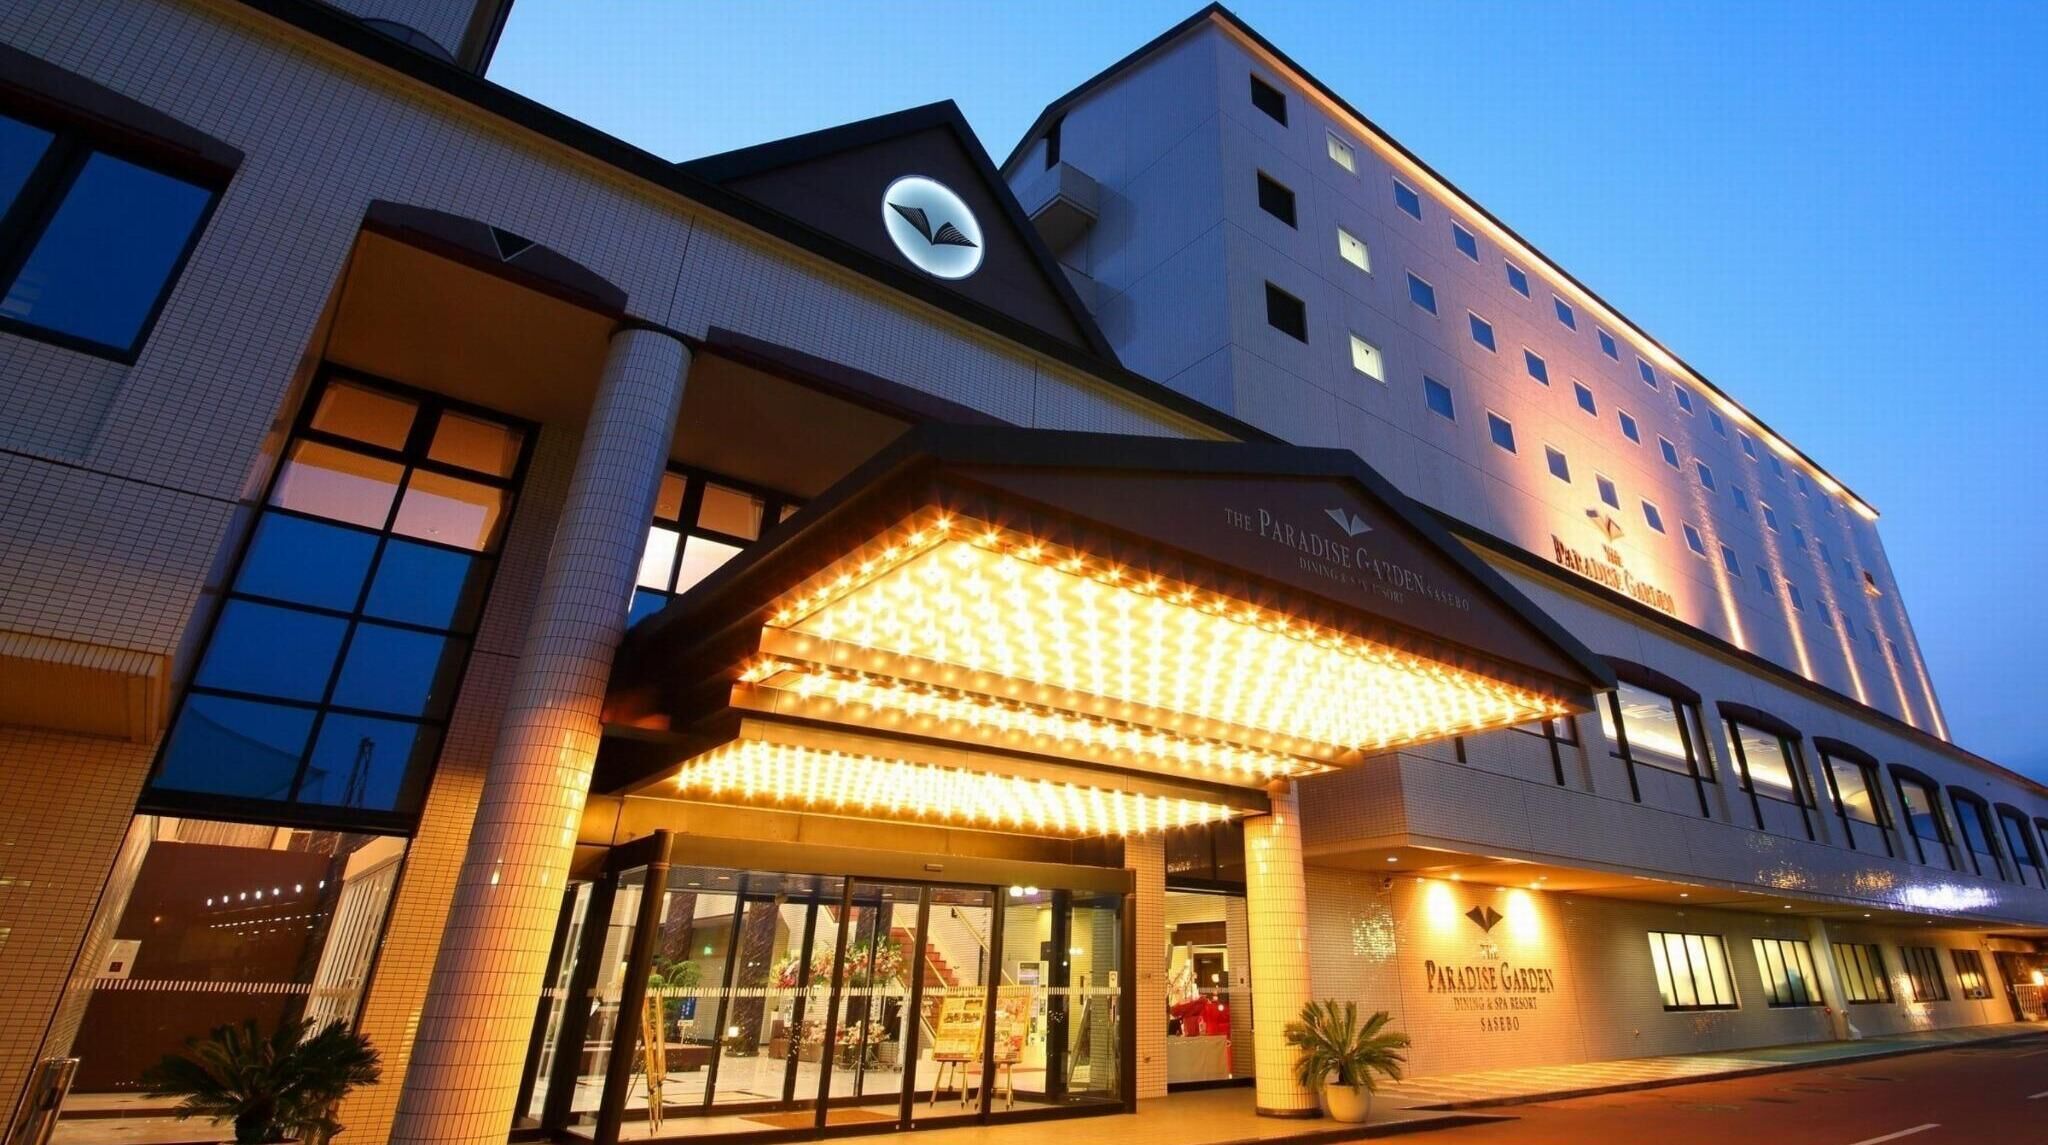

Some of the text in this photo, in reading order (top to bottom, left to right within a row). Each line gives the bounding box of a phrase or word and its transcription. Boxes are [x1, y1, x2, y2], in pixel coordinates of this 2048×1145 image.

[1224, 507, 1252, 531] THE
[1257, 508, 1351, 569] PARADISE
[1356, 547, 1425, 595] GARDEN
[1299, 556, 1339, 580] DINING
[1551, 533, 1676, 616] PARADISE GARDEN
[1425, 959, 1555, 993] PARADISE GARDEN
[1453, 996, 1537, 1011] DINING & SPA RESORT
[1480, 1016, 1520, 1032] SASEBO
